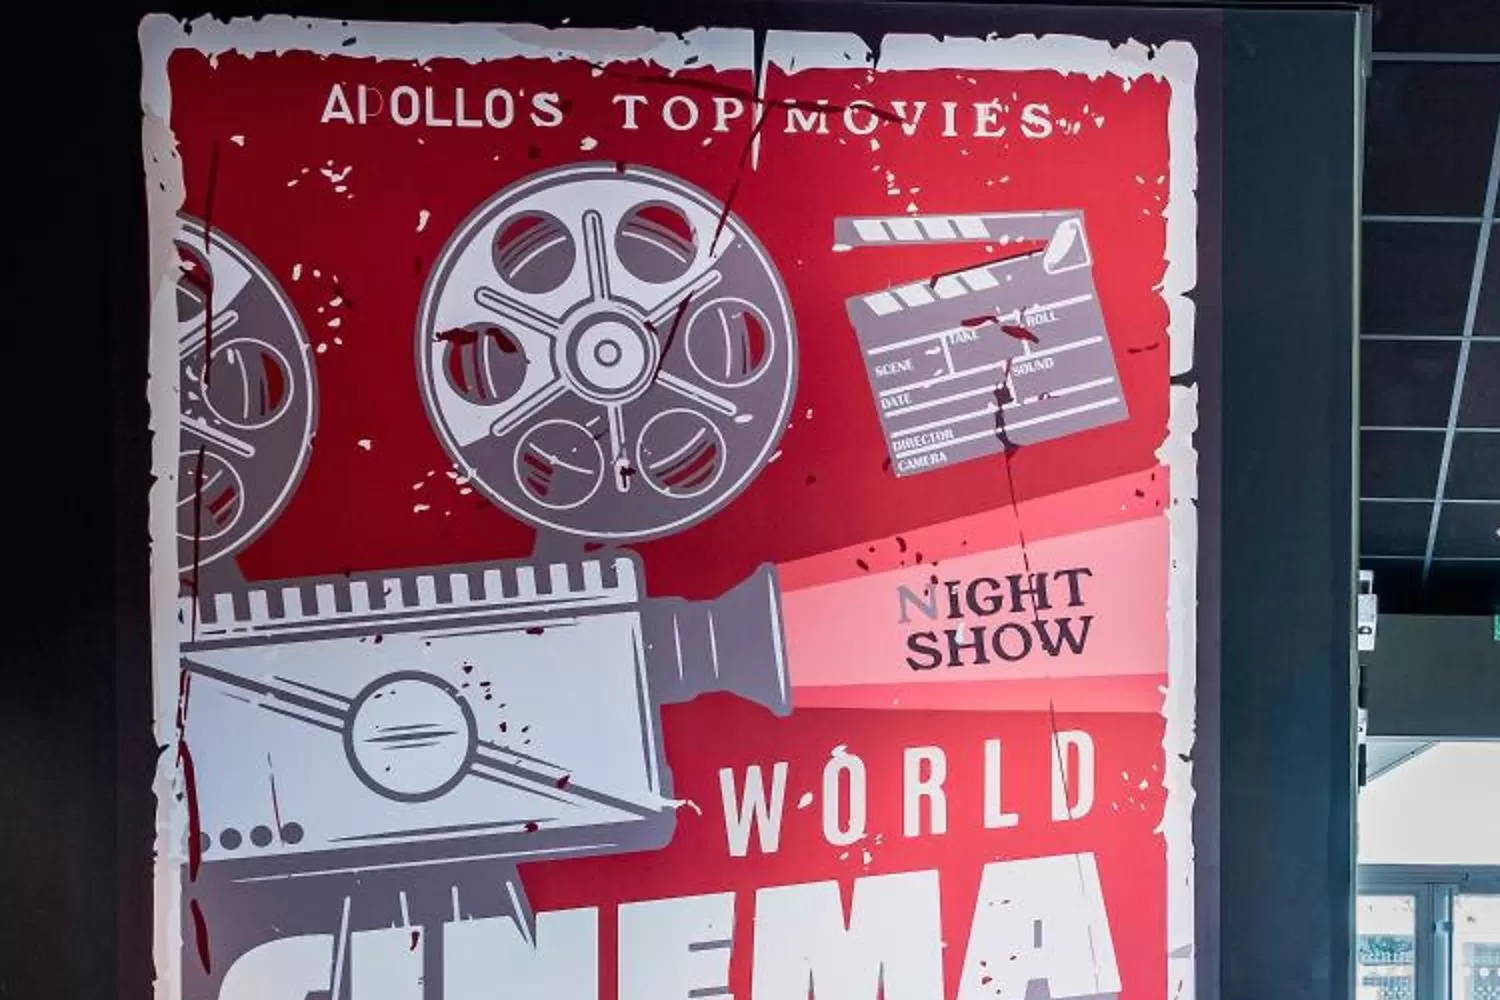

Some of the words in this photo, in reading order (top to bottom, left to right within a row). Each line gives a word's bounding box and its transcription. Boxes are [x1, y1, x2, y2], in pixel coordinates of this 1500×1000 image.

[320, 84, 564, 128] APOLLO'S
[612, 94, 744, 132] TOP
[784, 100, 1055, 138] MOVIES
[875, 359, 914, 377] SCENE
[1012, 357, 1055, 377] SOUND
[881, 393, 912, 409] DATE
[892, 429, 955, 451] DIRECTOR
[897, 453, 948, 473] CAMERA
[897, 566, 1095, 625] NIGHT
[905, 615, 1096, 672] SHOW
[718, 728, 1097, 858] WORLD
